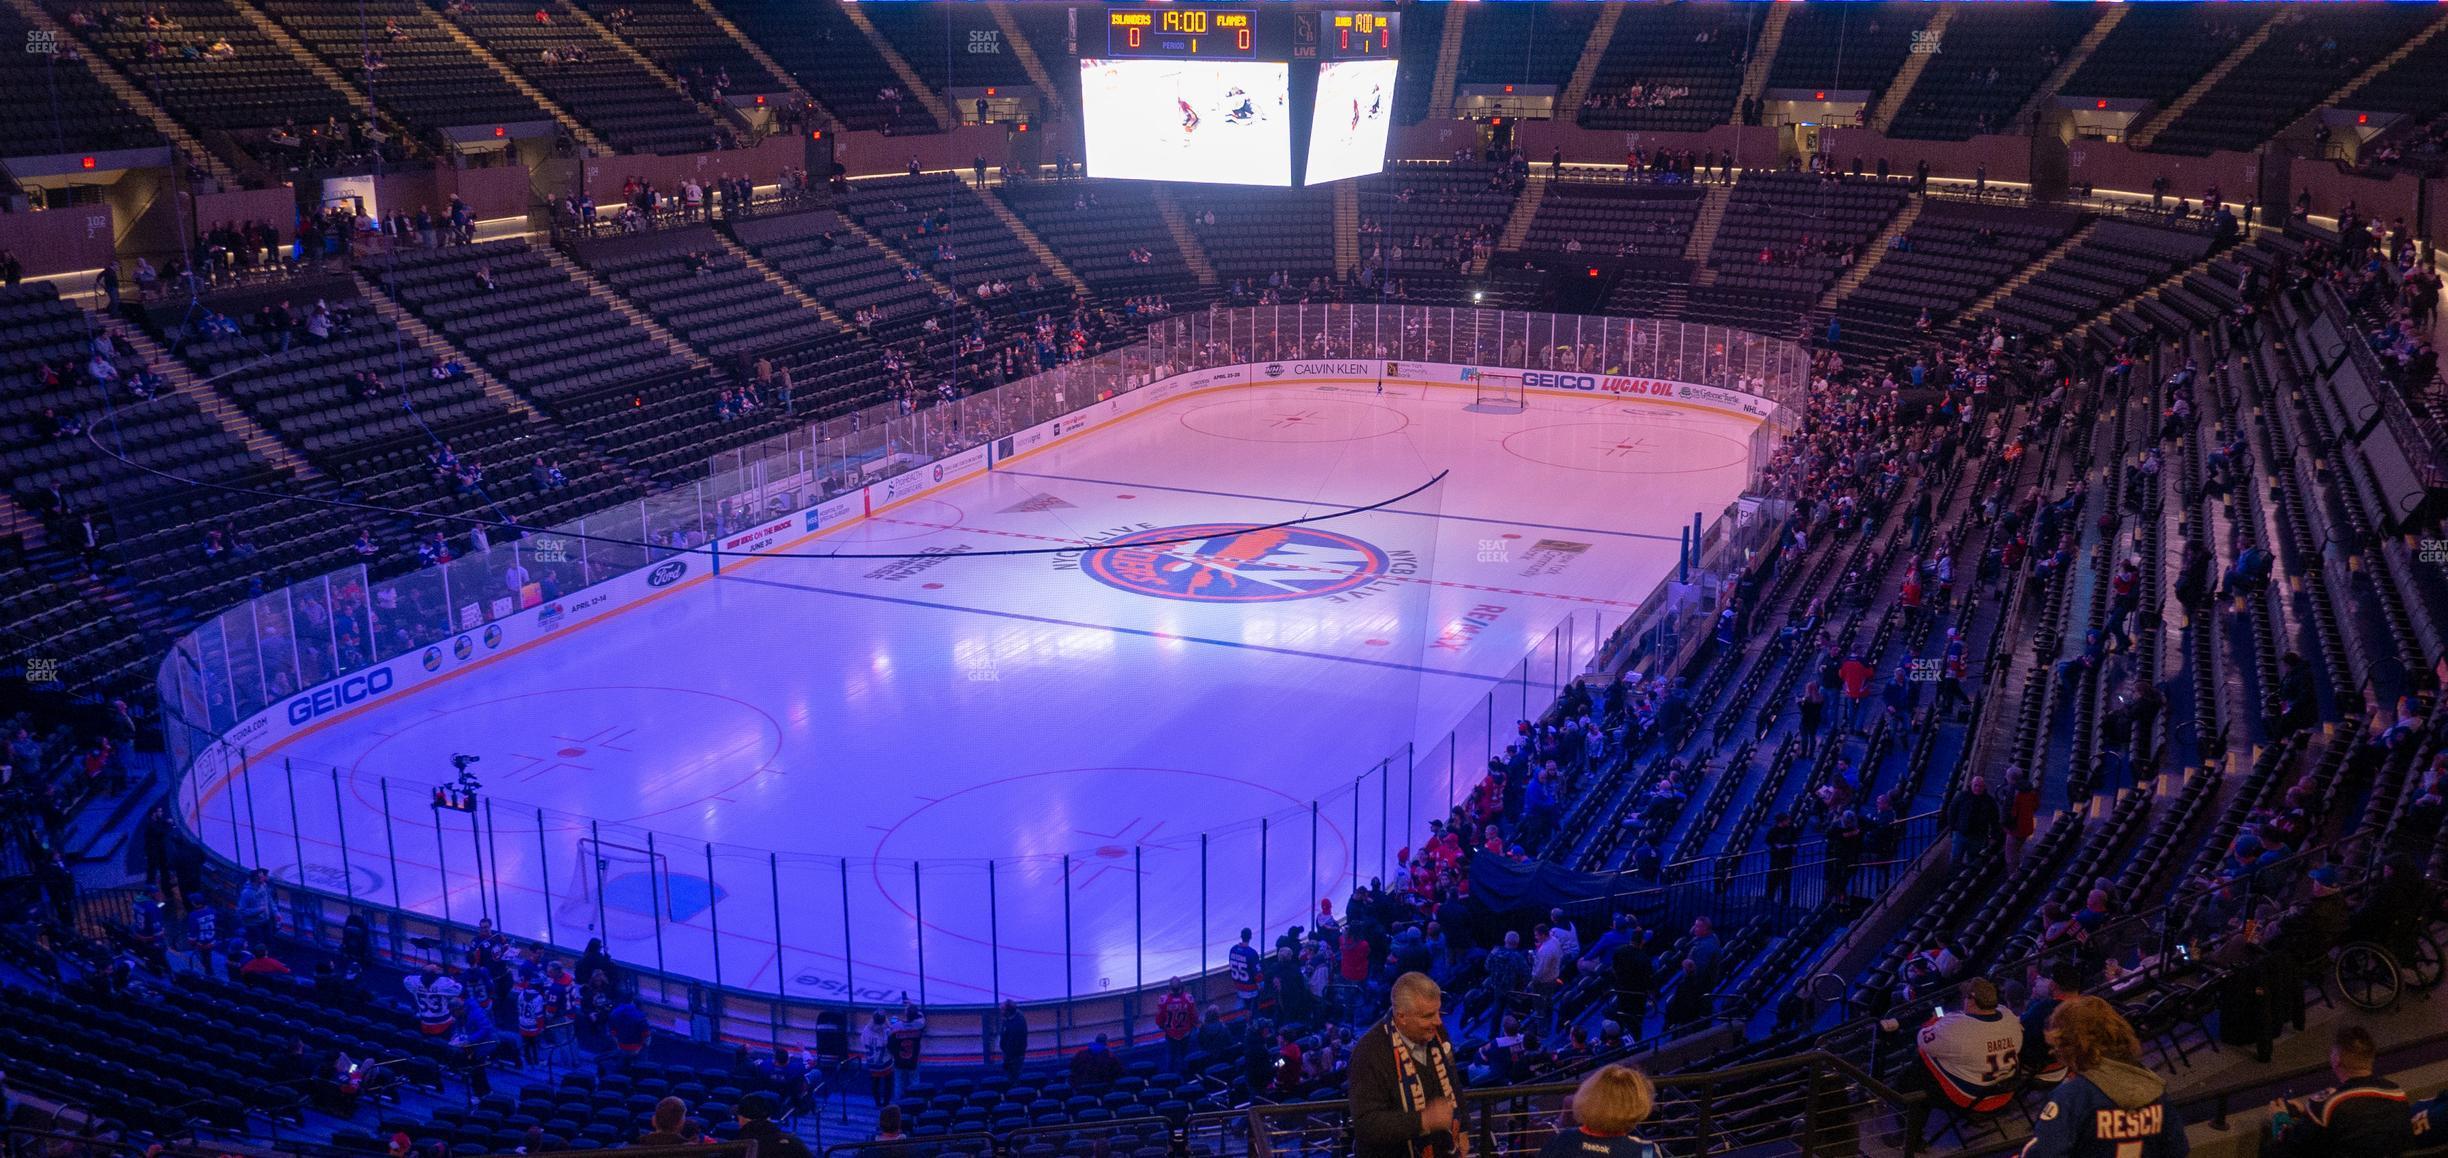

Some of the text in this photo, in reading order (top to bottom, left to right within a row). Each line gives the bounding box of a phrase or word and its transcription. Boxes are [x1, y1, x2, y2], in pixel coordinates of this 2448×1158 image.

[1111, 14, 1247, 26] ISLANDERS FLAMES
[1163, 11, 1206, 32] 19:00
[1129, 27, 1140, 47] 0
[1238, 29, 1250, 49] 0
[1294, 47, 1316, 56] LIVE
[86, 215, 106, 228] 102
[88, 228, 96, 239] 2
[1294, 363, 1368, 376] CALVIN KLEIN
[1522, 372, 1596, 391] GEICO
[1601, 377, 1674, 397] LUCAS OIL
[754, 530, 763, 540] ON
[763, 526, 775, 536] THE
[1084, 522, 1158, 545] LIVE
[749, 540, 766, 552] JUNE
[1053, 545, 1083, 571] NYC
[1388, 549, 1418, 576] NYCB
[653, 563, 684, 585] Ford
[571, 600, 591, 613] APRIL
[288, 666, 394, 726] GEICO
[1230, 960, 1250, 981] 55
[1986, 1037, 2016, 1054] BARZAL
[2096, 1104, 2164, 1140] RESCH
